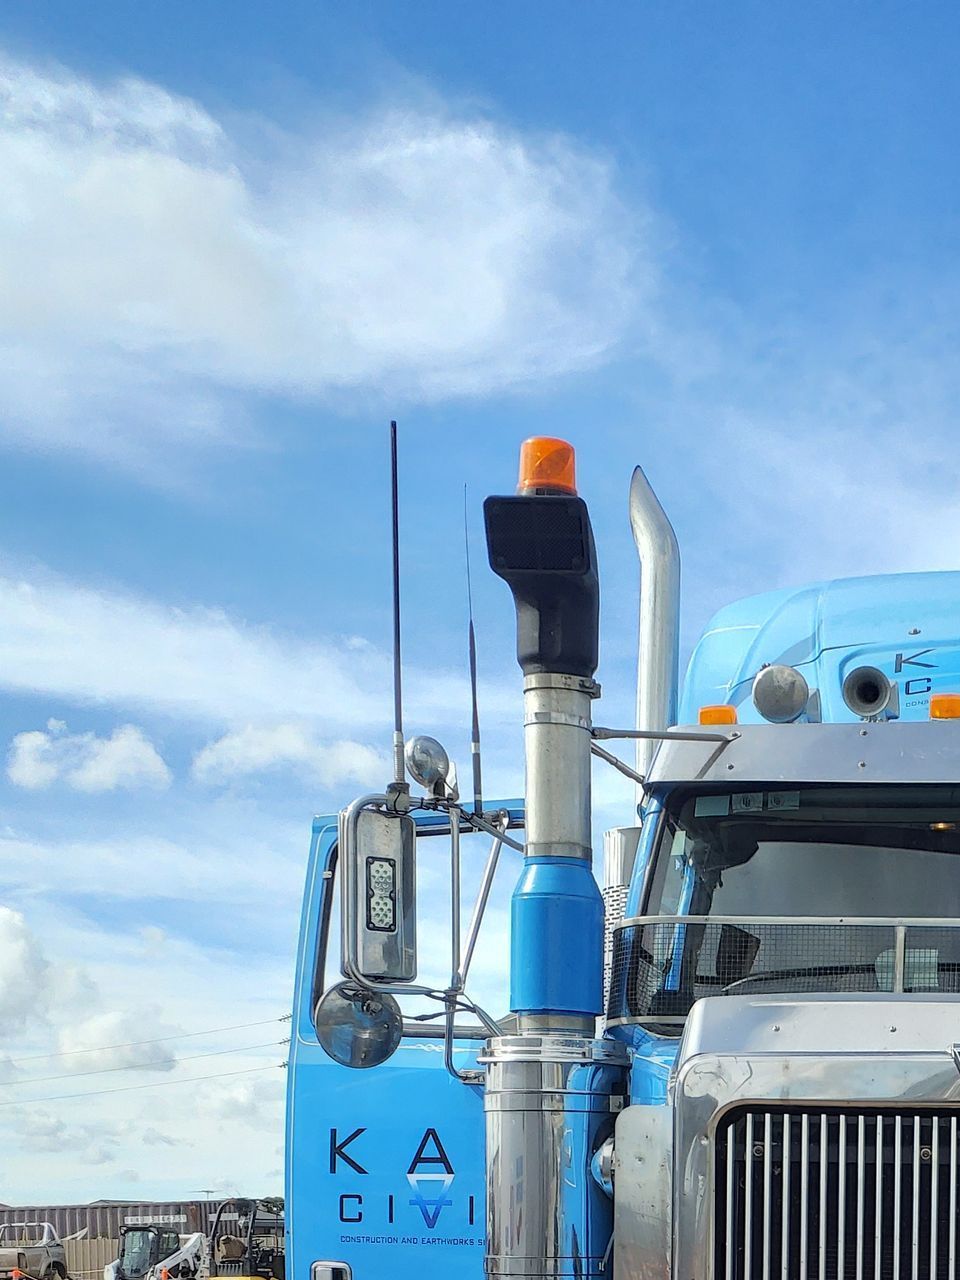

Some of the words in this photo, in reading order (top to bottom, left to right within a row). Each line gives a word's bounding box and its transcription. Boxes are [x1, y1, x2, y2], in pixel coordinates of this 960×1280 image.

[329, 1127, 455, 1175] KA
[339, 1194, 475, 1229] CIVI
[340, 1235, 399, 1244] CONSTRUCTION
[401, 1237, 418, 1245] AND
[421, 1237, 475, 1246] EARTHWORKS
